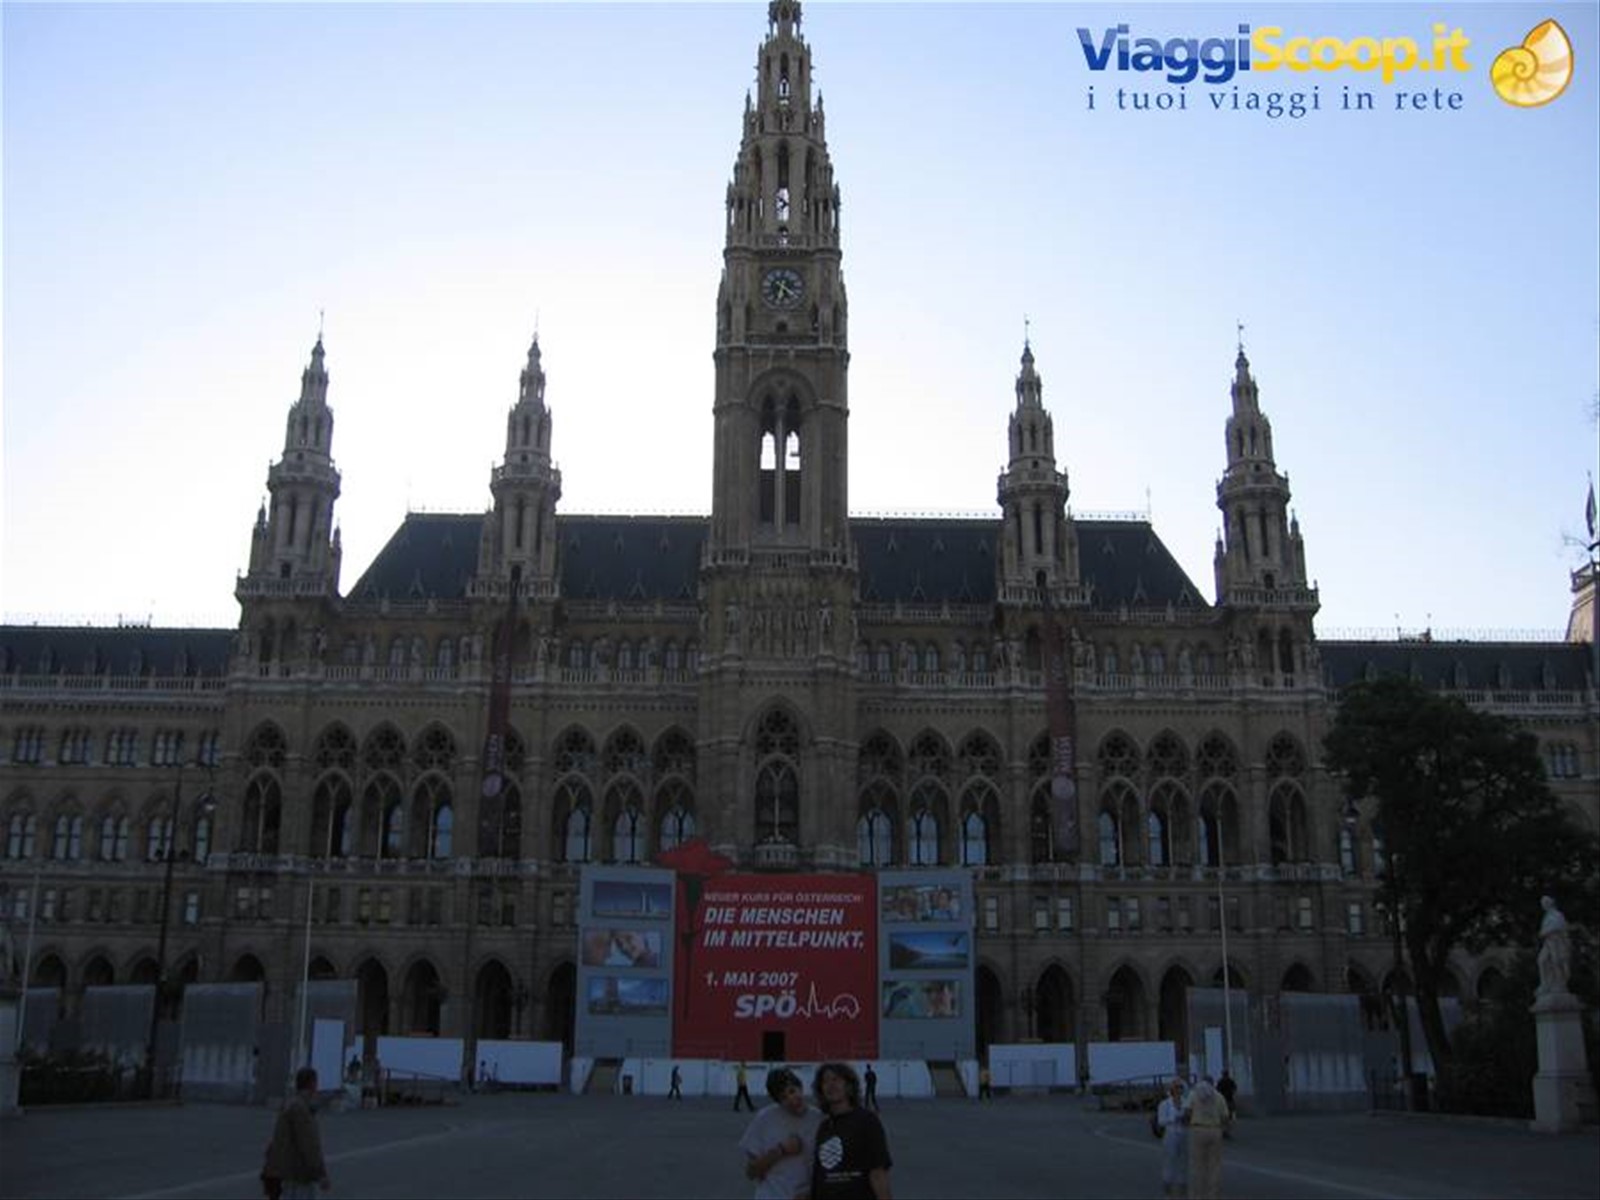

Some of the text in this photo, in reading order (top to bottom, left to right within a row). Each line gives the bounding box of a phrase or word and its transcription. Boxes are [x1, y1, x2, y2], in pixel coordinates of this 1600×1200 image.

[704, 892, 740, 903] NEUER
[742, 892, 770, 903] KURS
[772, 891, 794, 903] FÜR
[704, 907, 845, 925] DIE MENSCHEN
[703, 930, 864, 948] IM MITTELPUNKT.
[706, 971, 799, 986] 1. MAI 2007
[735, 990, 797, 1018] SPÖ
